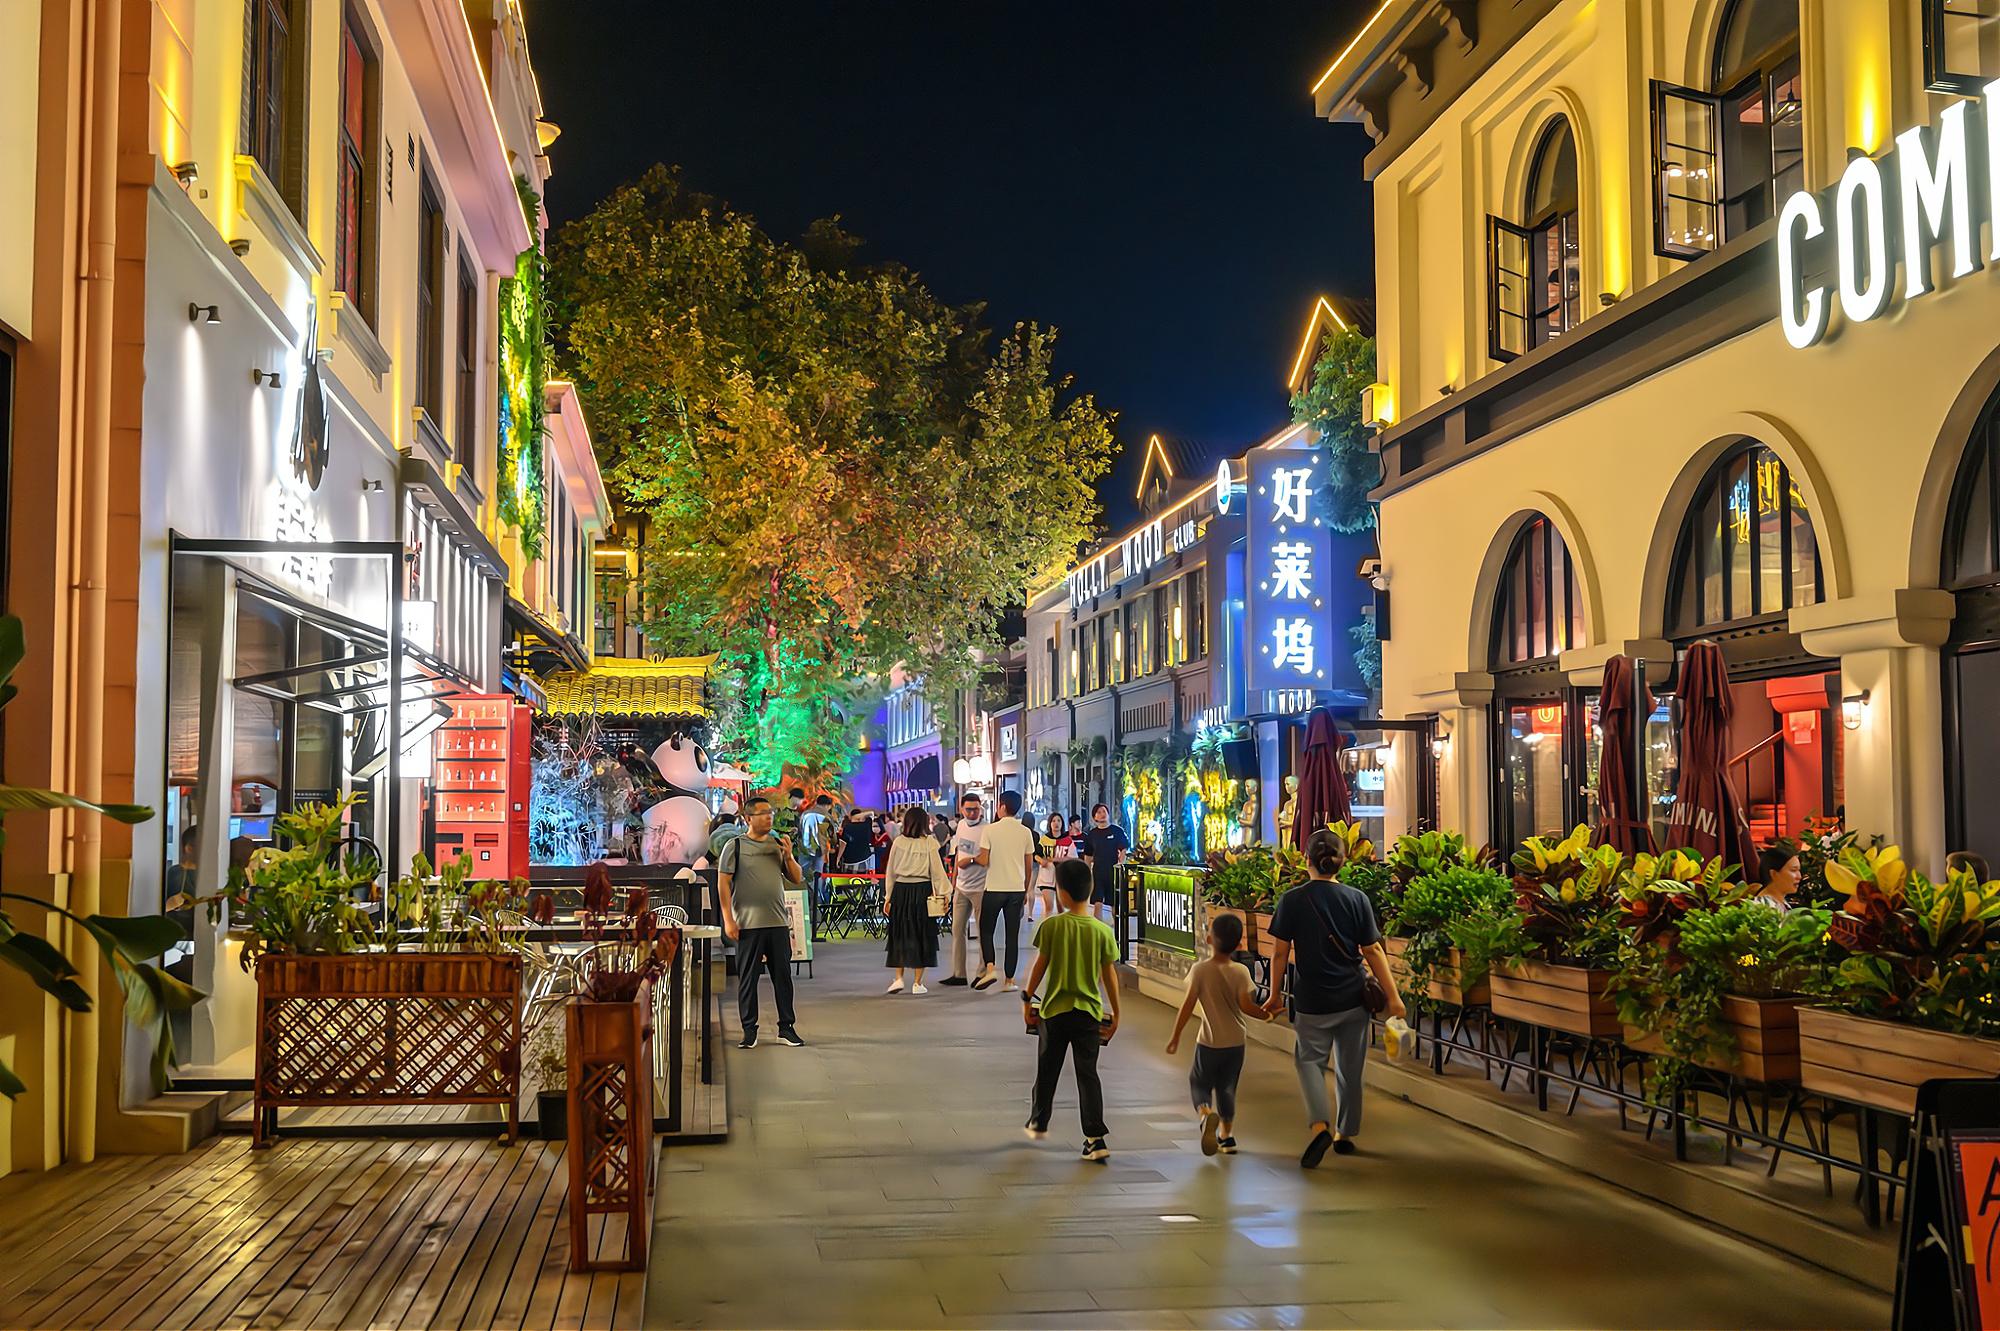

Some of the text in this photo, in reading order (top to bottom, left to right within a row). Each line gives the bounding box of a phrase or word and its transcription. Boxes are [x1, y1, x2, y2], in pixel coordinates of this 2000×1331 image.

[1777, 78, 2000, 349] COM
[1069, 519, 1195, 609] HOLLY WOOD CLUB
[1271, 467, 1314, 675] 好莱坞
[1203, 688, 1312, 727] HOLLY WOOD
[1145, 888, 1187, 932] COMMUNE
